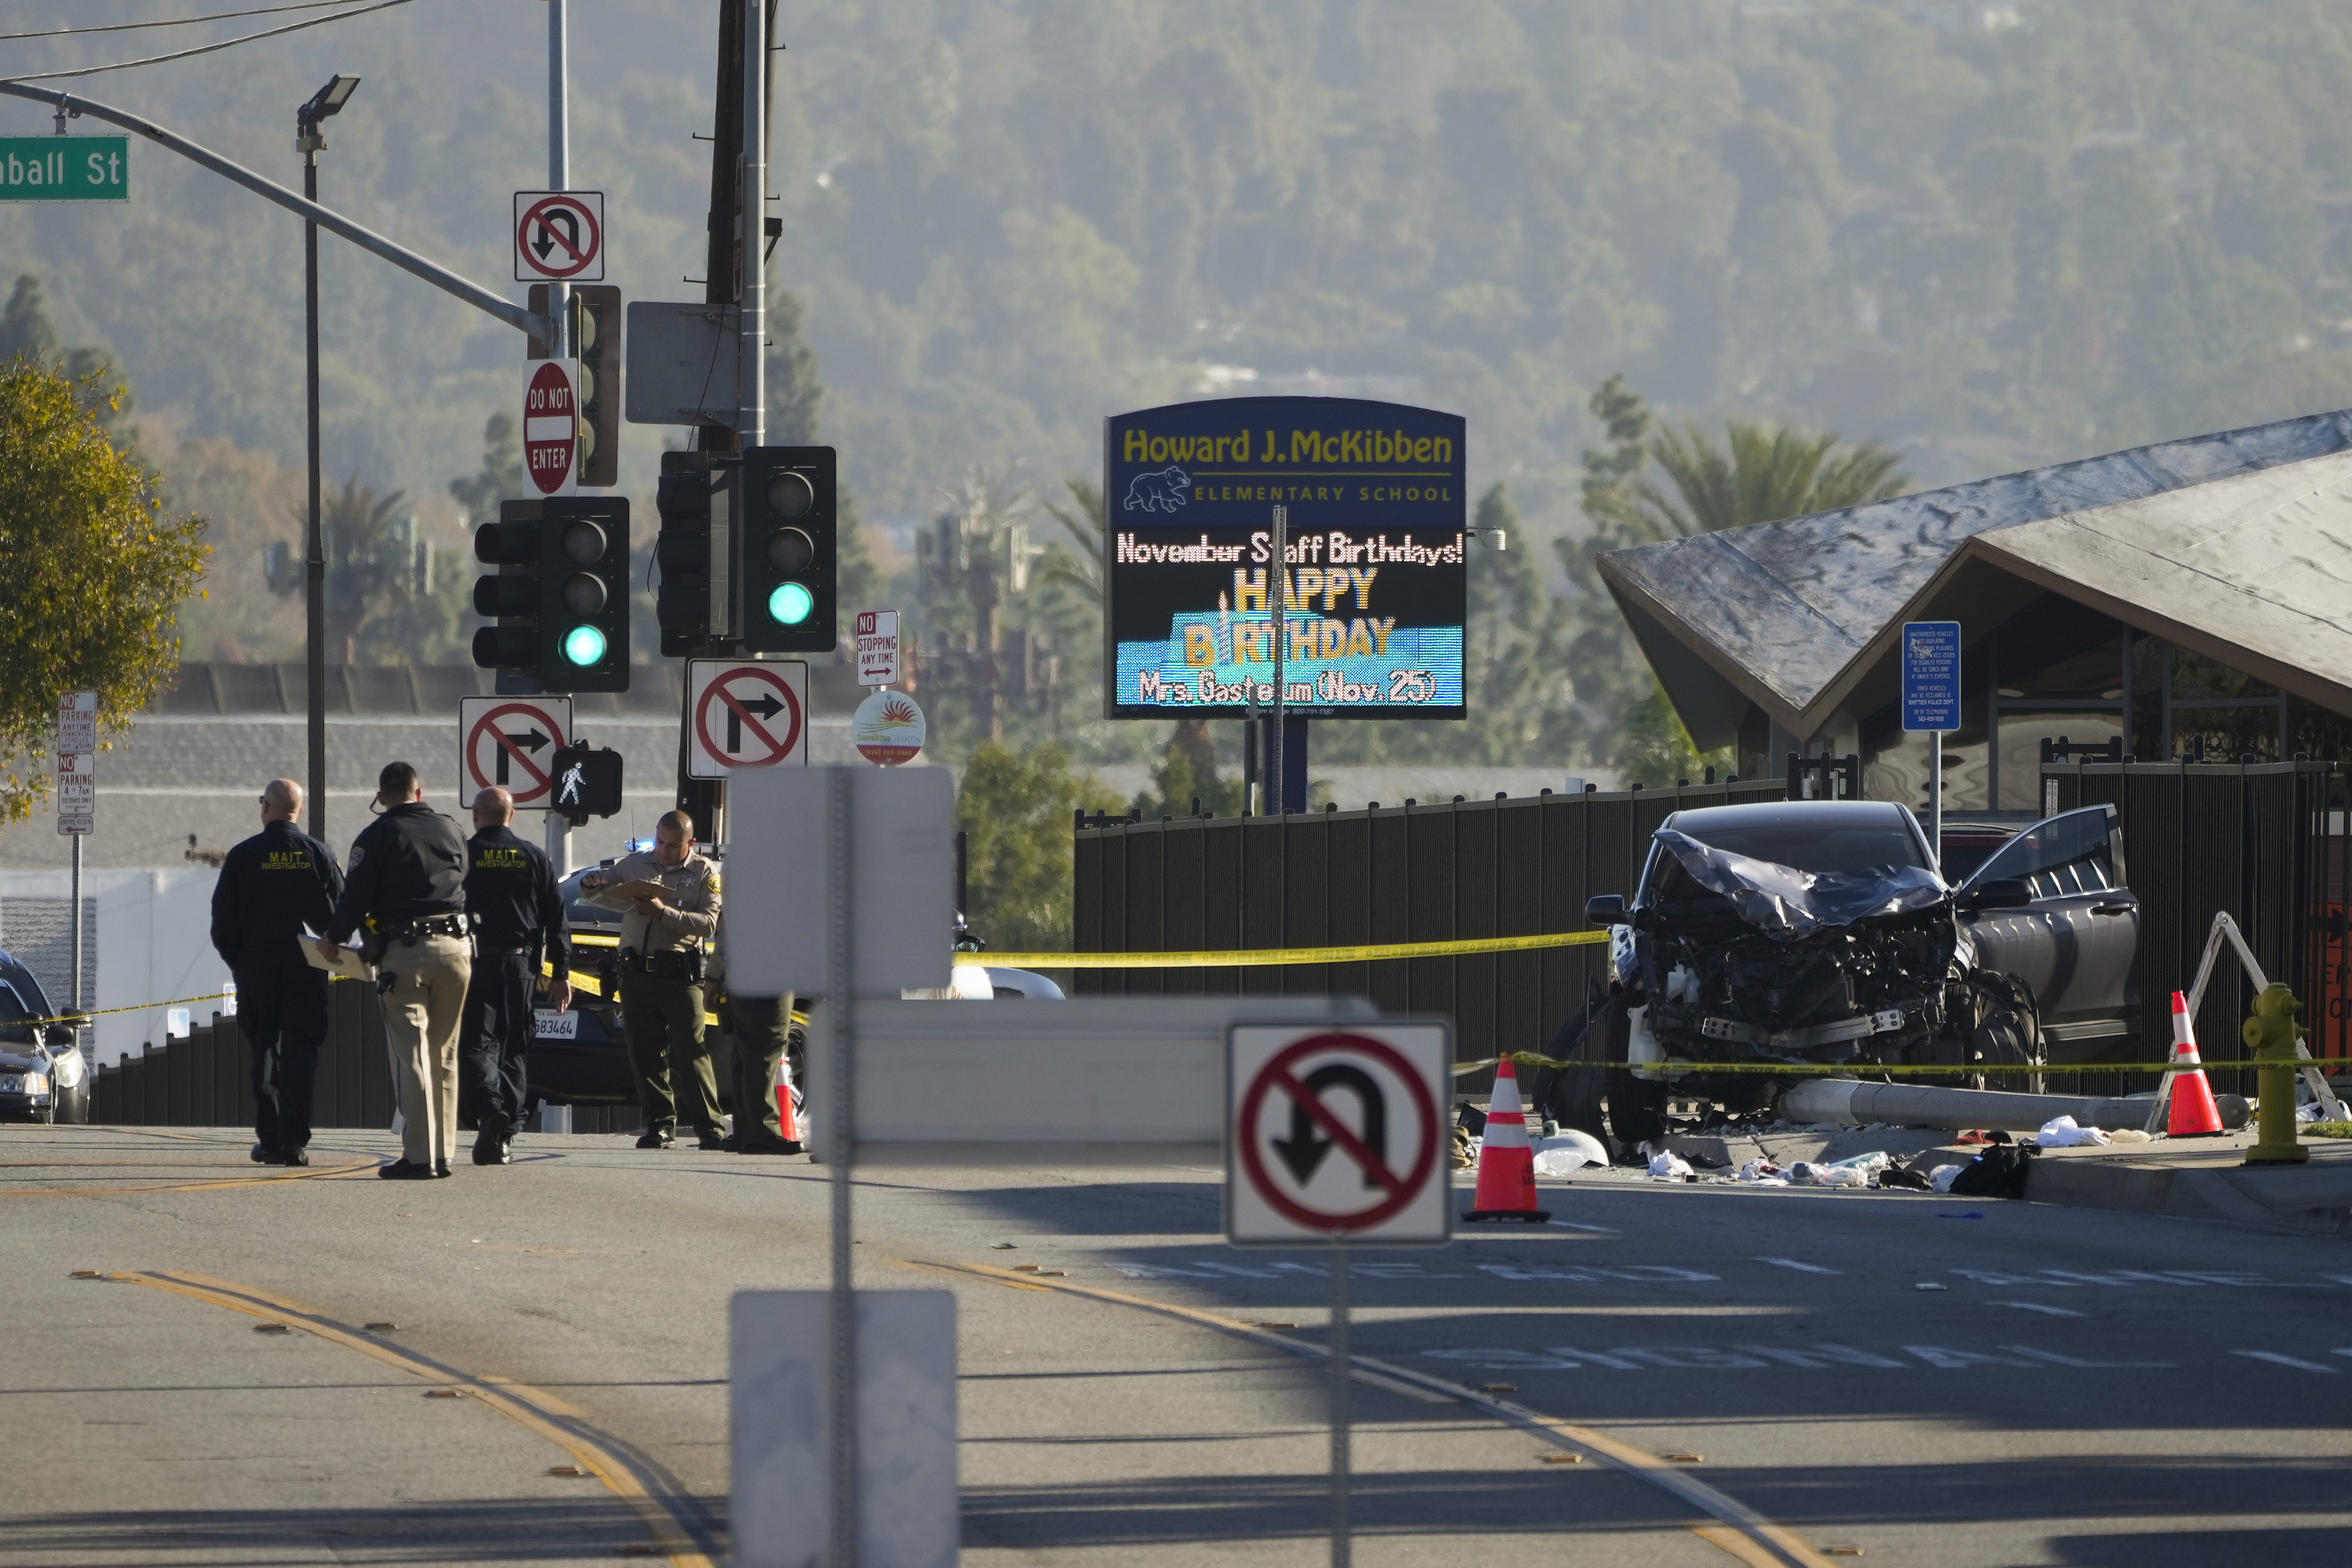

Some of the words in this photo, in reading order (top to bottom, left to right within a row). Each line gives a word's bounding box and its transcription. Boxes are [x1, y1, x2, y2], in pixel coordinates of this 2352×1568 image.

[87, 152, 120, 185] St
[530, 388, 544, 409] DO
[549, 388, 569, 408] NOT
[1124, 430, 1250, 462] Howard
[1261, 430, 1286, 462] J.
[1291, 430, 1452, 463] McKibben
[533, 448, 566, 469] ENTER
[1195, 487, 1344, 501] ELEMENTARY
[1360, 487, 1451, 502] SCHOOL
[1117, 533, 1245, 563] November
[1251, 532, 1323, 563] Saff
[1328, 532, 1463, 566] Birthdays!
[859, 615, 873, 632] NO
[858, 636, 896, 652] STOPPING
[861, 654, 876, 665] ANY
[879, 653, 894, 663] TIME
[1139, 669, 1193, 703] Mrs.
[1317, 669, 1385, 703] (Nov.
[1389, 669, 1436, 703] 25)
[60, 694, 74, 708] NO
[61, 711, 92, 722] PARKING
[60, 756, 73, 770] NO
[60, 774, 92, 786] PARKING
[64, 786, 68, 796] 4
